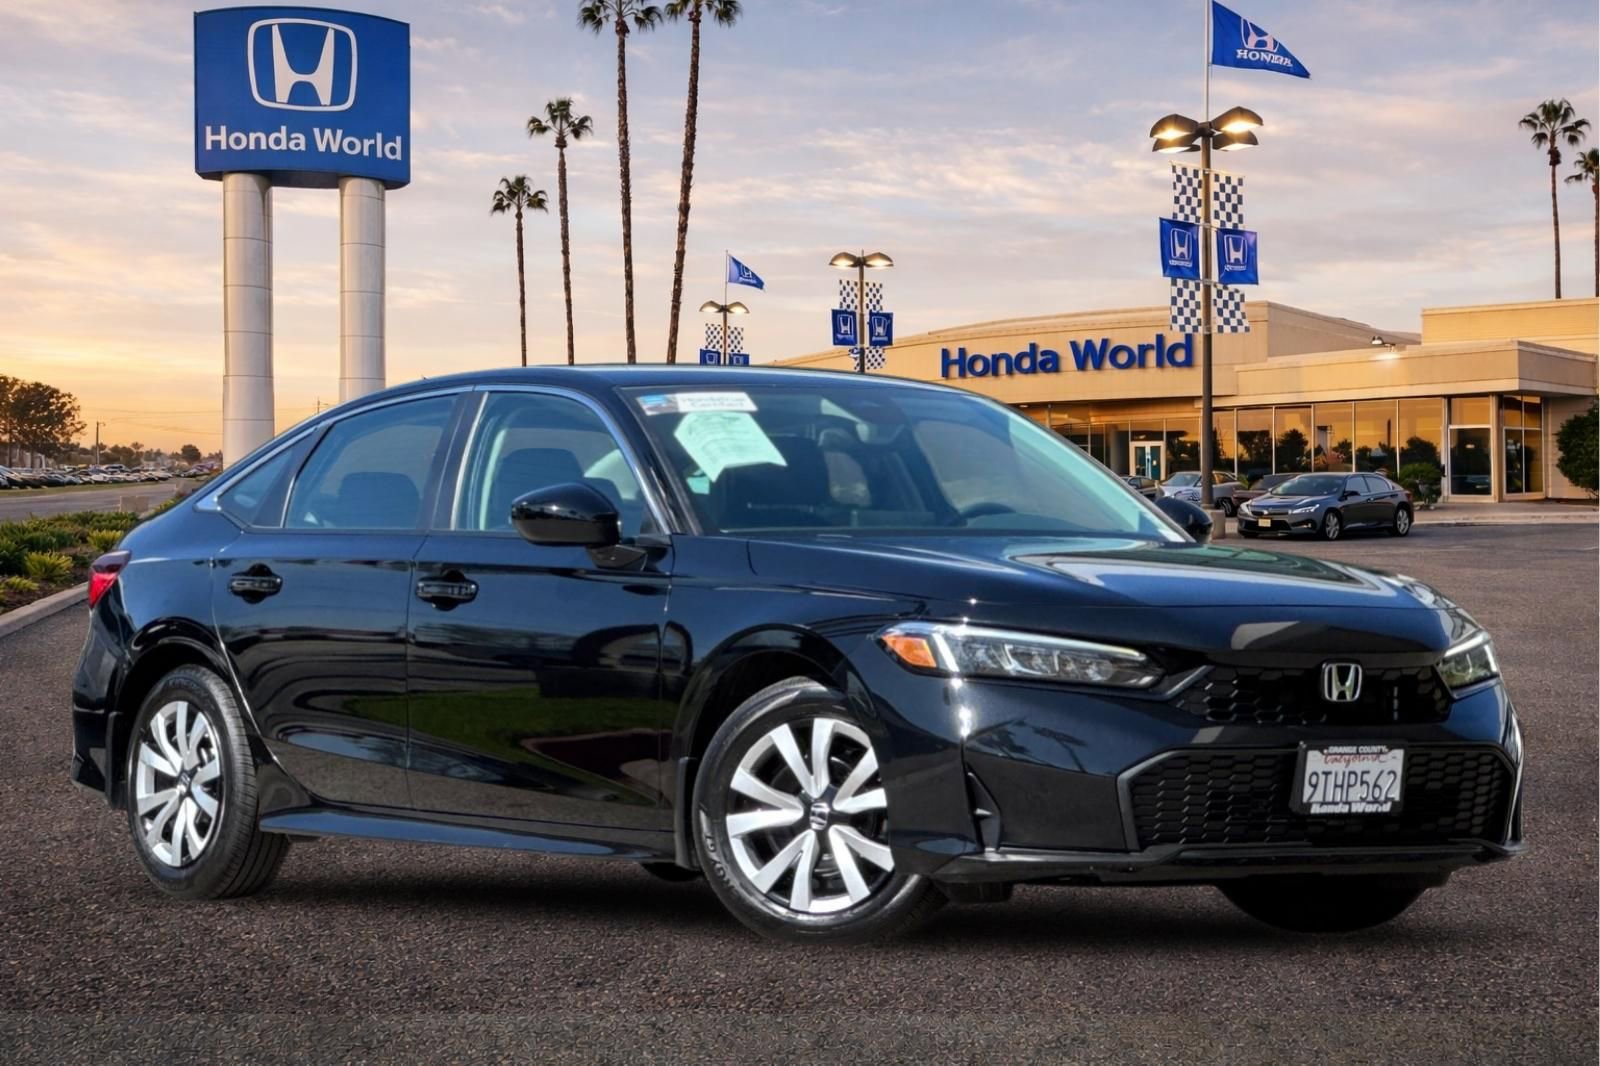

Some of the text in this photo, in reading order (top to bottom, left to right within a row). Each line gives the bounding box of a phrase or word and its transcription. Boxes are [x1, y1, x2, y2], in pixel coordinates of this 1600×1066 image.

[205, 125, 402, 161] Honda World
[941, 333, 1194, 379] Honda World
[1307, 770, 1397, 801] 9THP562
[1350, 801, 1392, 813] World
